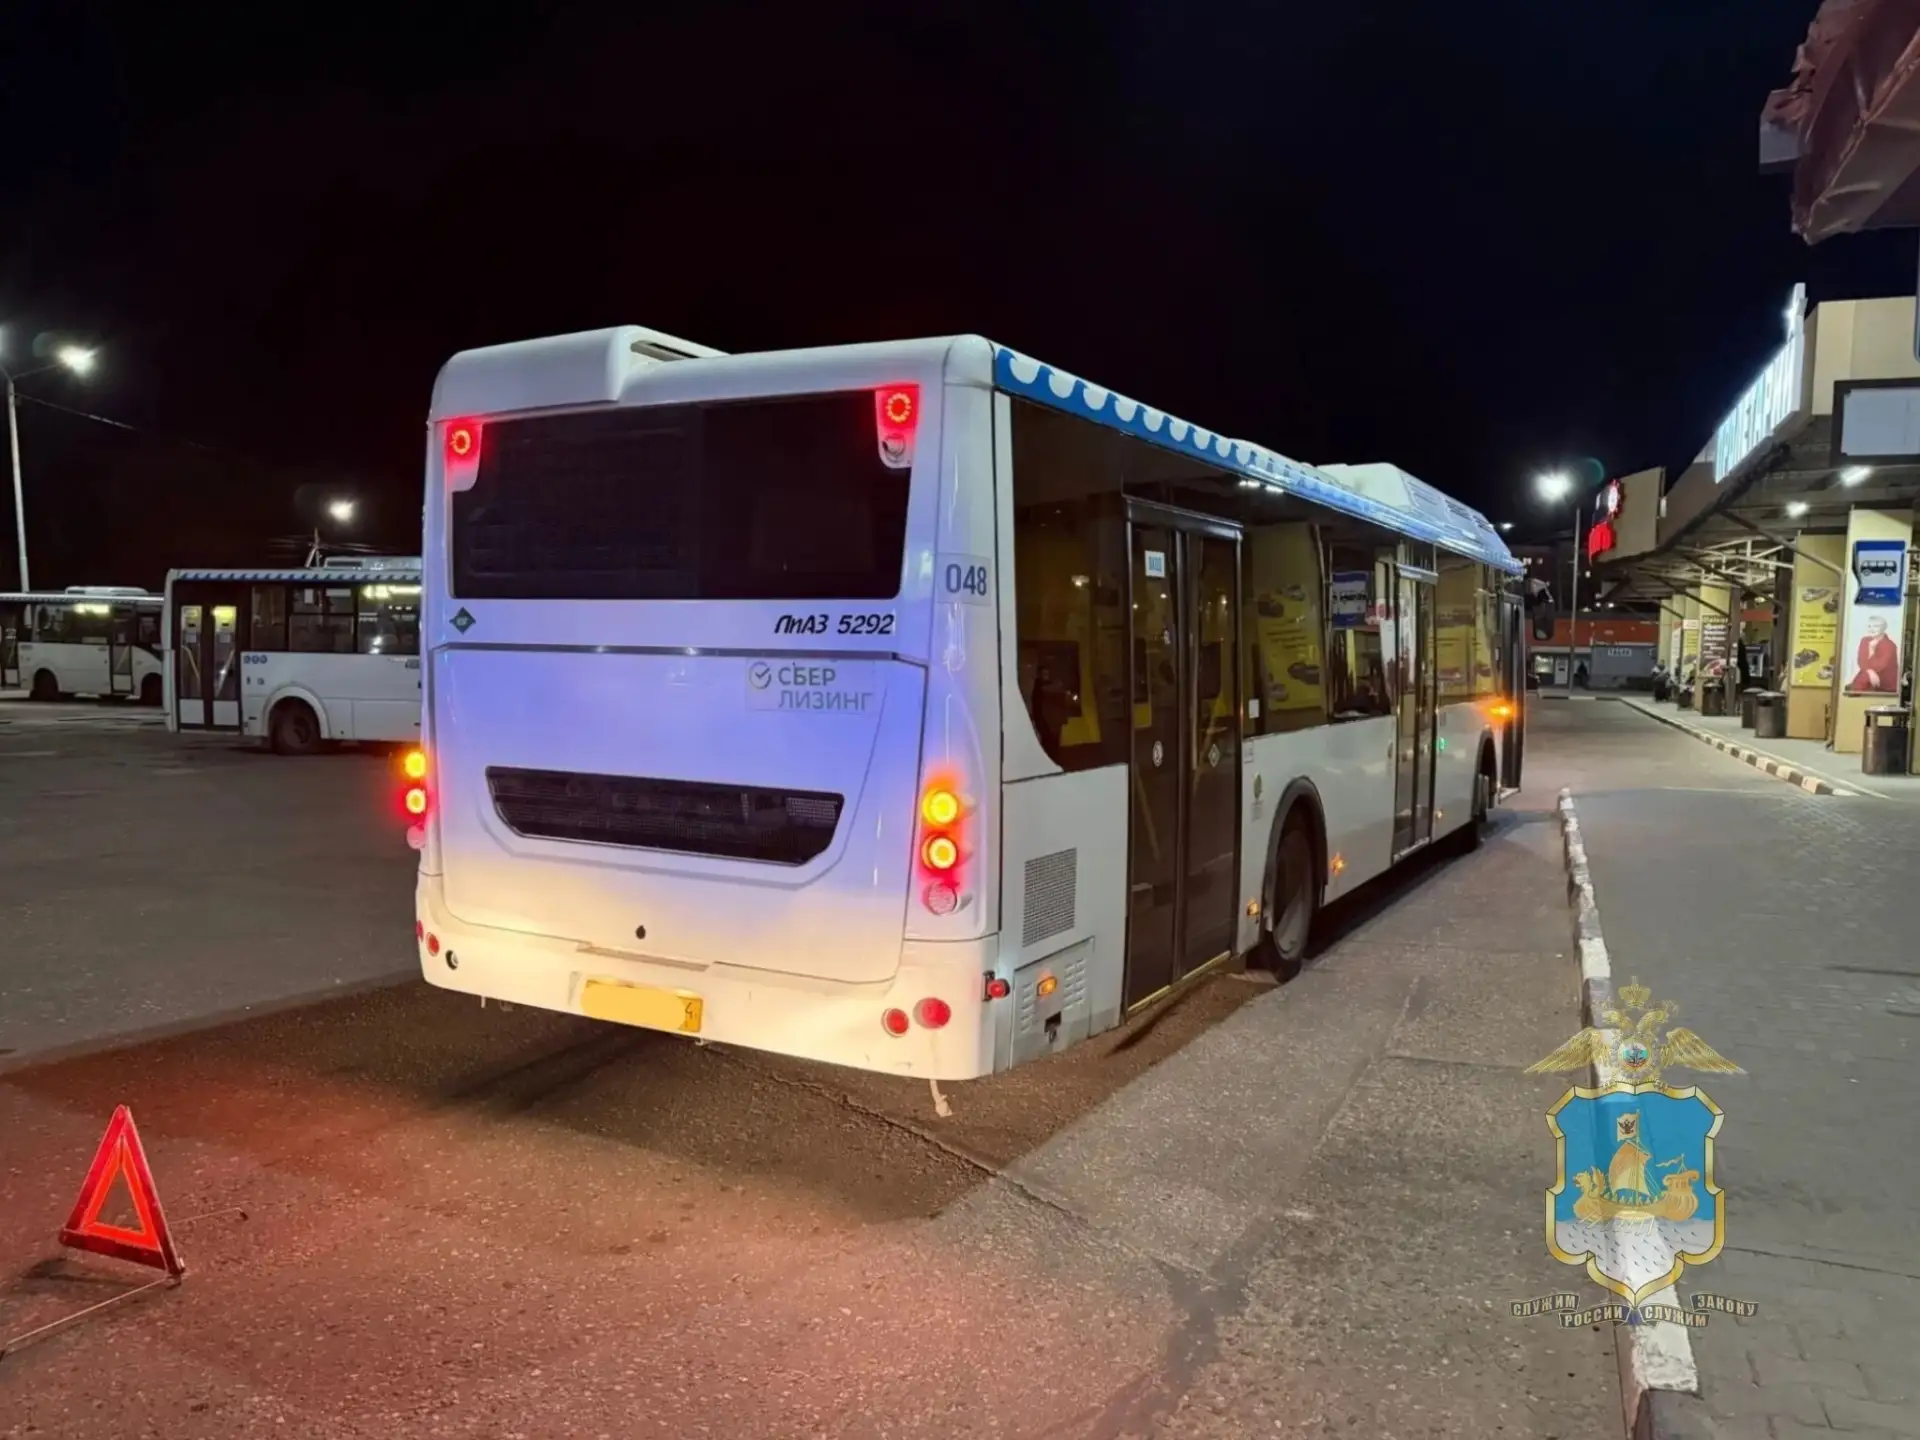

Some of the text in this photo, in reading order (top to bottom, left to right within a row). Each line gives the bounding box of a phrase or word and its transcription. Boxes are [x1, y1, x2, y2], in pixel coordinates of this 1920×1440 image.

[946, 563, 987, 596] 048
[837, 614, 895, 635] 5292
[778, 667, 836, 687] СБЕР
[778, 690, 873, 711] ЛИЗИНГ
